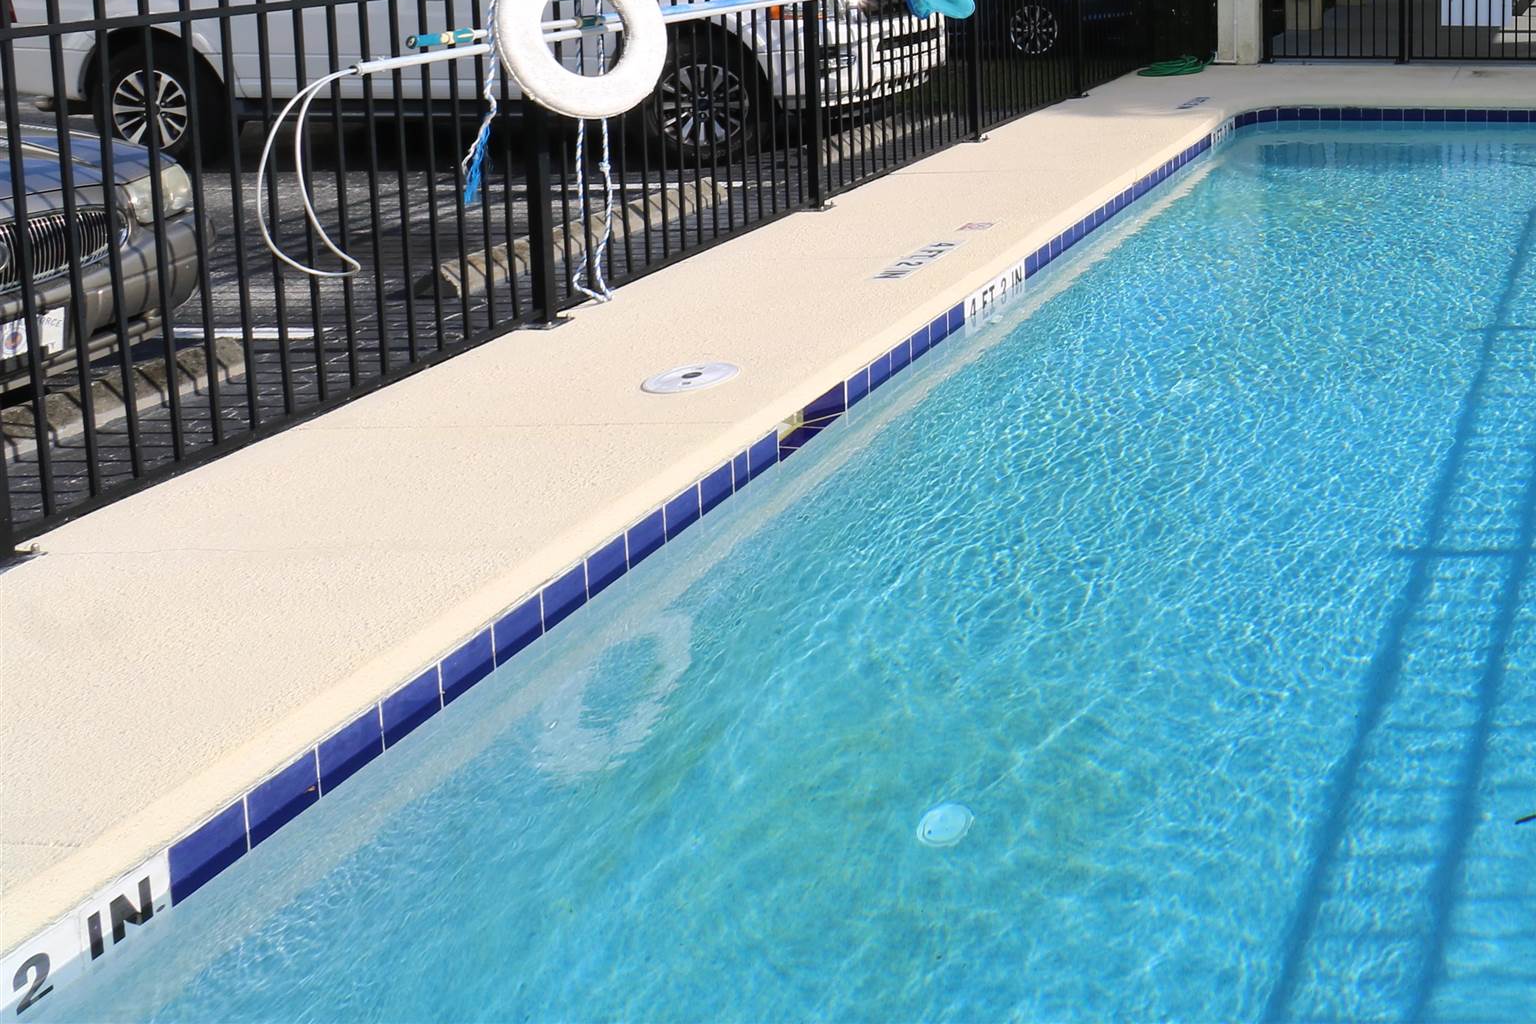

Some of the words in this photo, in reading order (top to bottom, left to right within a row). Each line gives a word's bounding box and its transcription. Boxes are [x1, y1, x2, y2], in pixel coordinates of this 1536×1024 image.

[970, 297, 977, 317] 4
[982, 285, 995, 309] FT
[1011, 265, 1022, 288] IN
[13, 952, 54, 1015] 2
